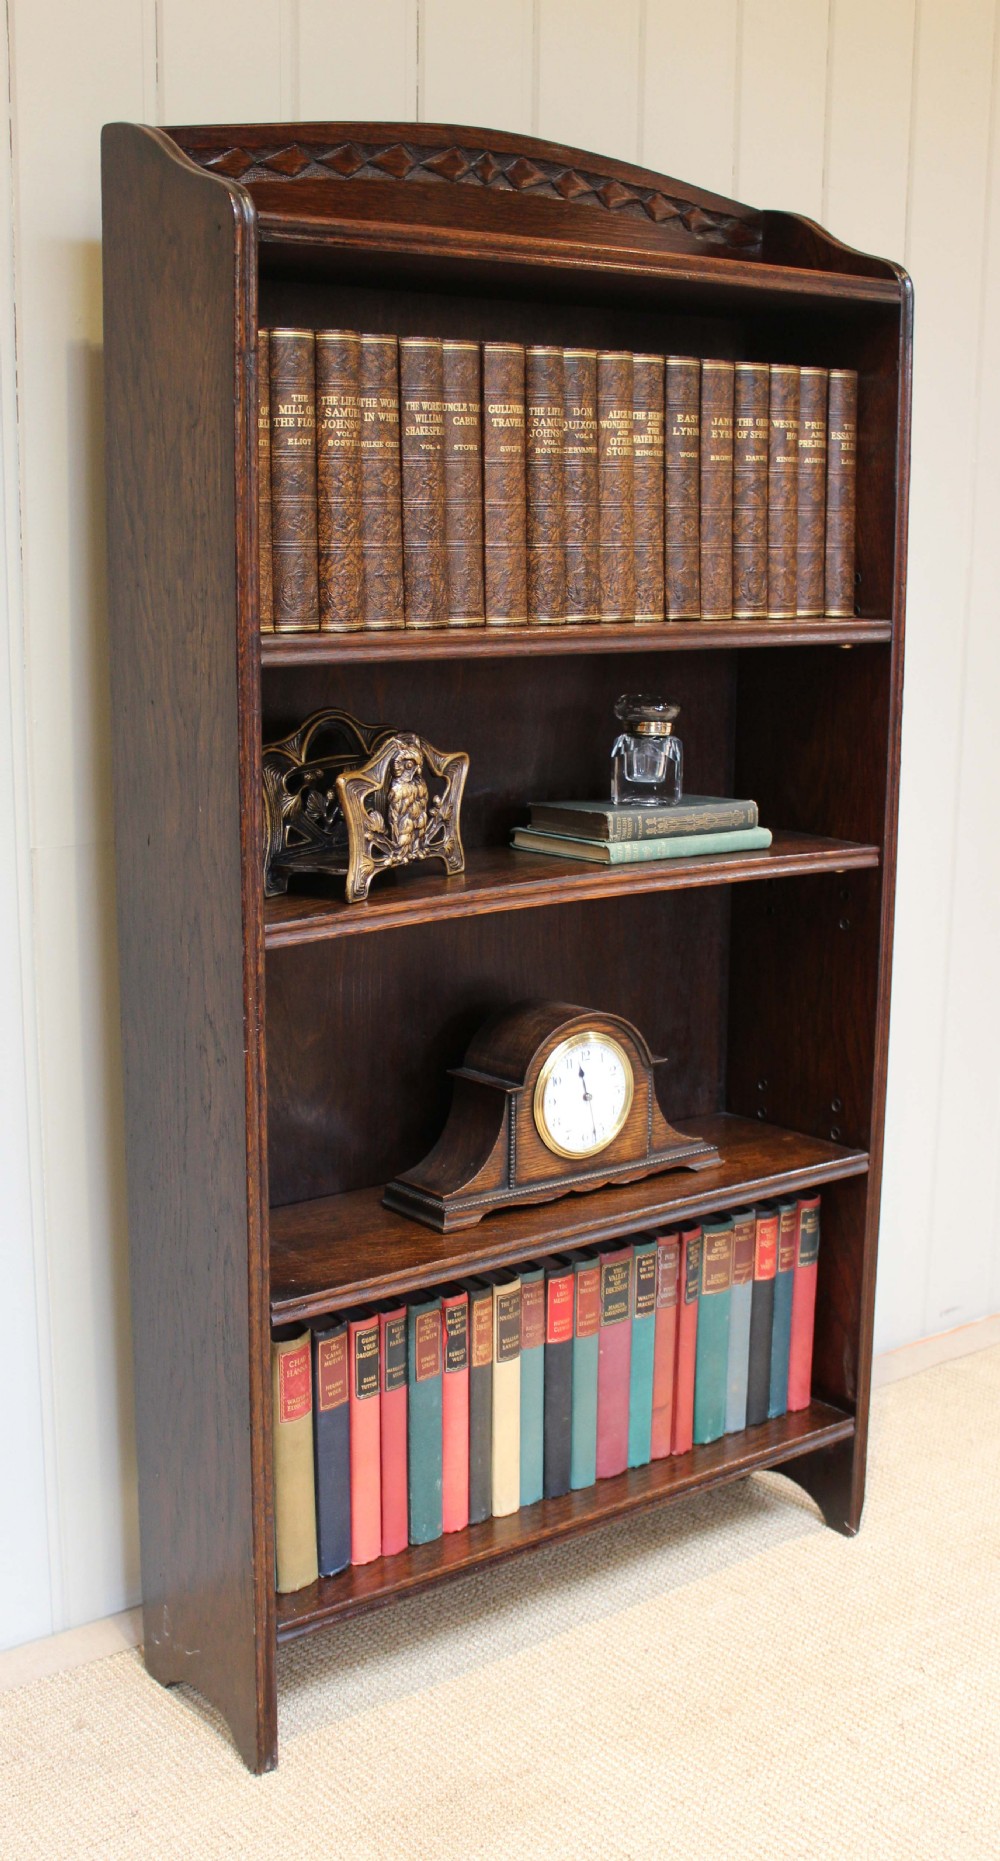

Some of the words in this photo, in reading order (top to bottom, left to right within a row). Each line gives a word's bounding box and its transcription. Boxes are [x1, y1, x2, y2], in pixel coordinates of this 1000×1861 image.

[291, 394, 308, 402] THE
[321, 396, 338, 406] THE
[360, 398, 378, 408] THE
[278, 404, 304, 414] MILL
[404, 402, 420, 411] THE
[442, 402, 467, 412] UNCLE
[529, 407, 546, 416] THE
[364, 412, 376, 422] IN
[573, 408, 594, 416] DON
[274, 418, 295, 428] THE
[736, 418, 754, 427] THE
[736, 430, 748, 439] OF
[608, 1271, 626, 1282] VALLEY
